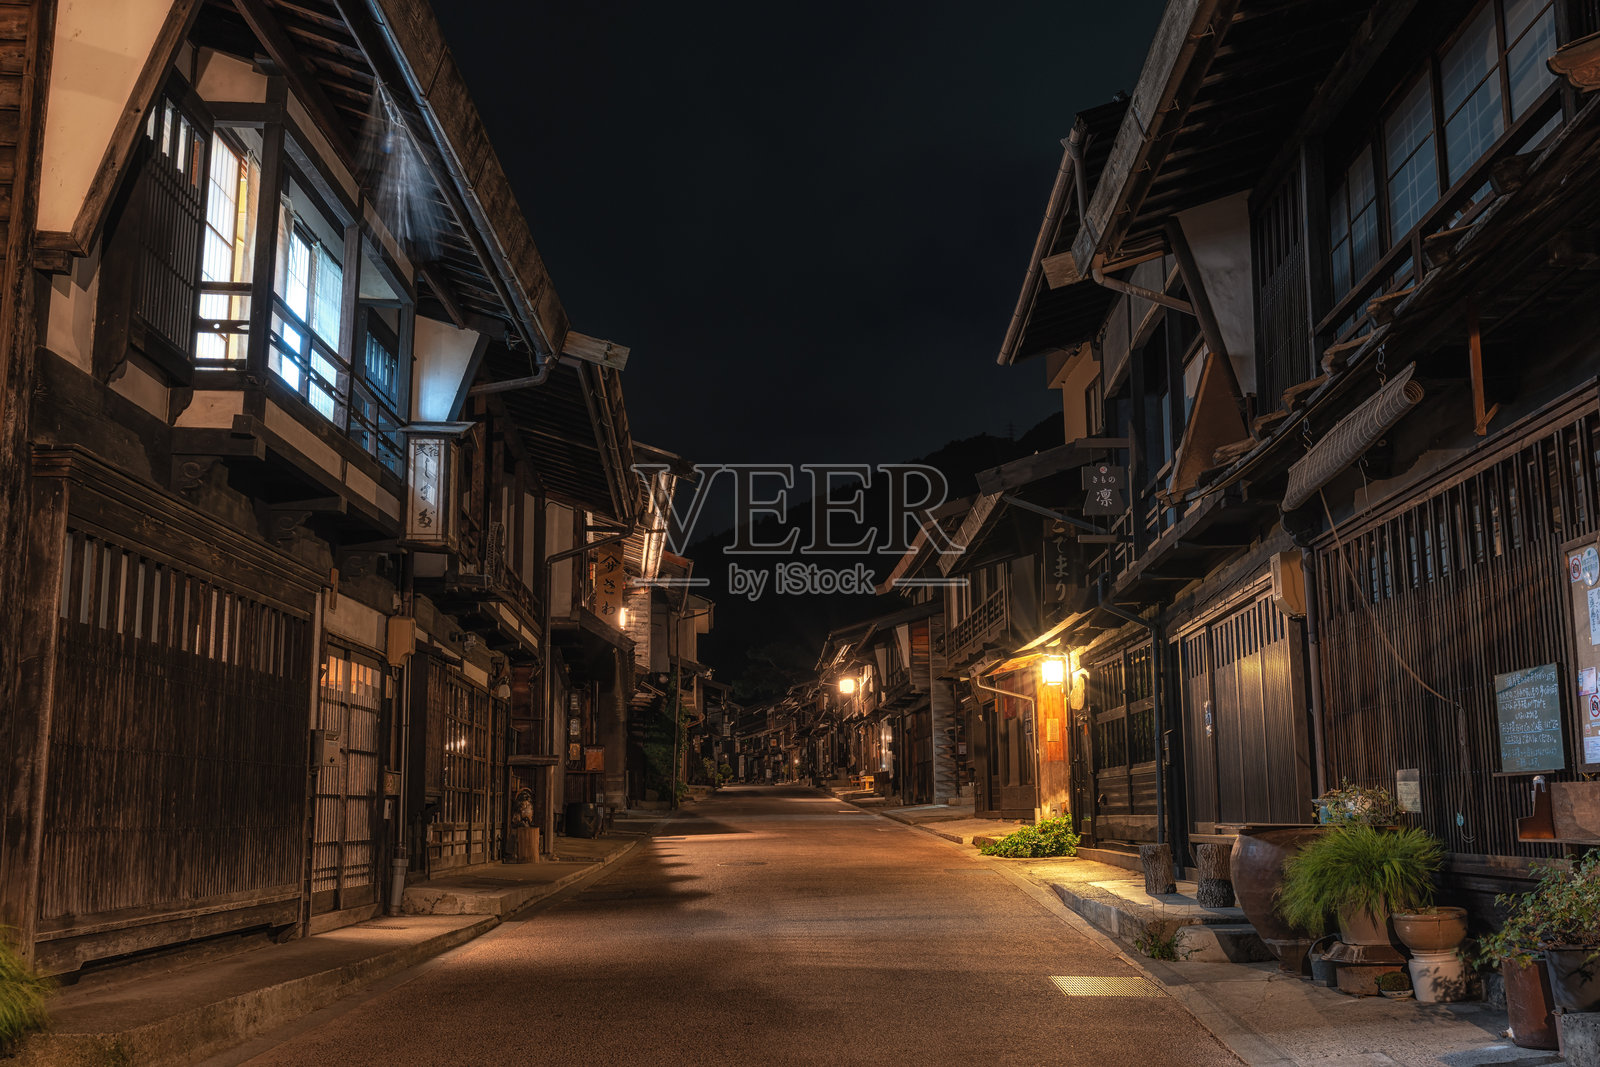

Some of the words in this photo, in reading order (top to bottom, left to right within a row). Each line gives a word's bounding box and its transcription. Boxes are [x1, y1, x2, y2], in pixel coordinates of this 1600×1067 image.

[1092, 475, 1116, 484] きもの
[1052, 518, 1070, 602] こでまり
